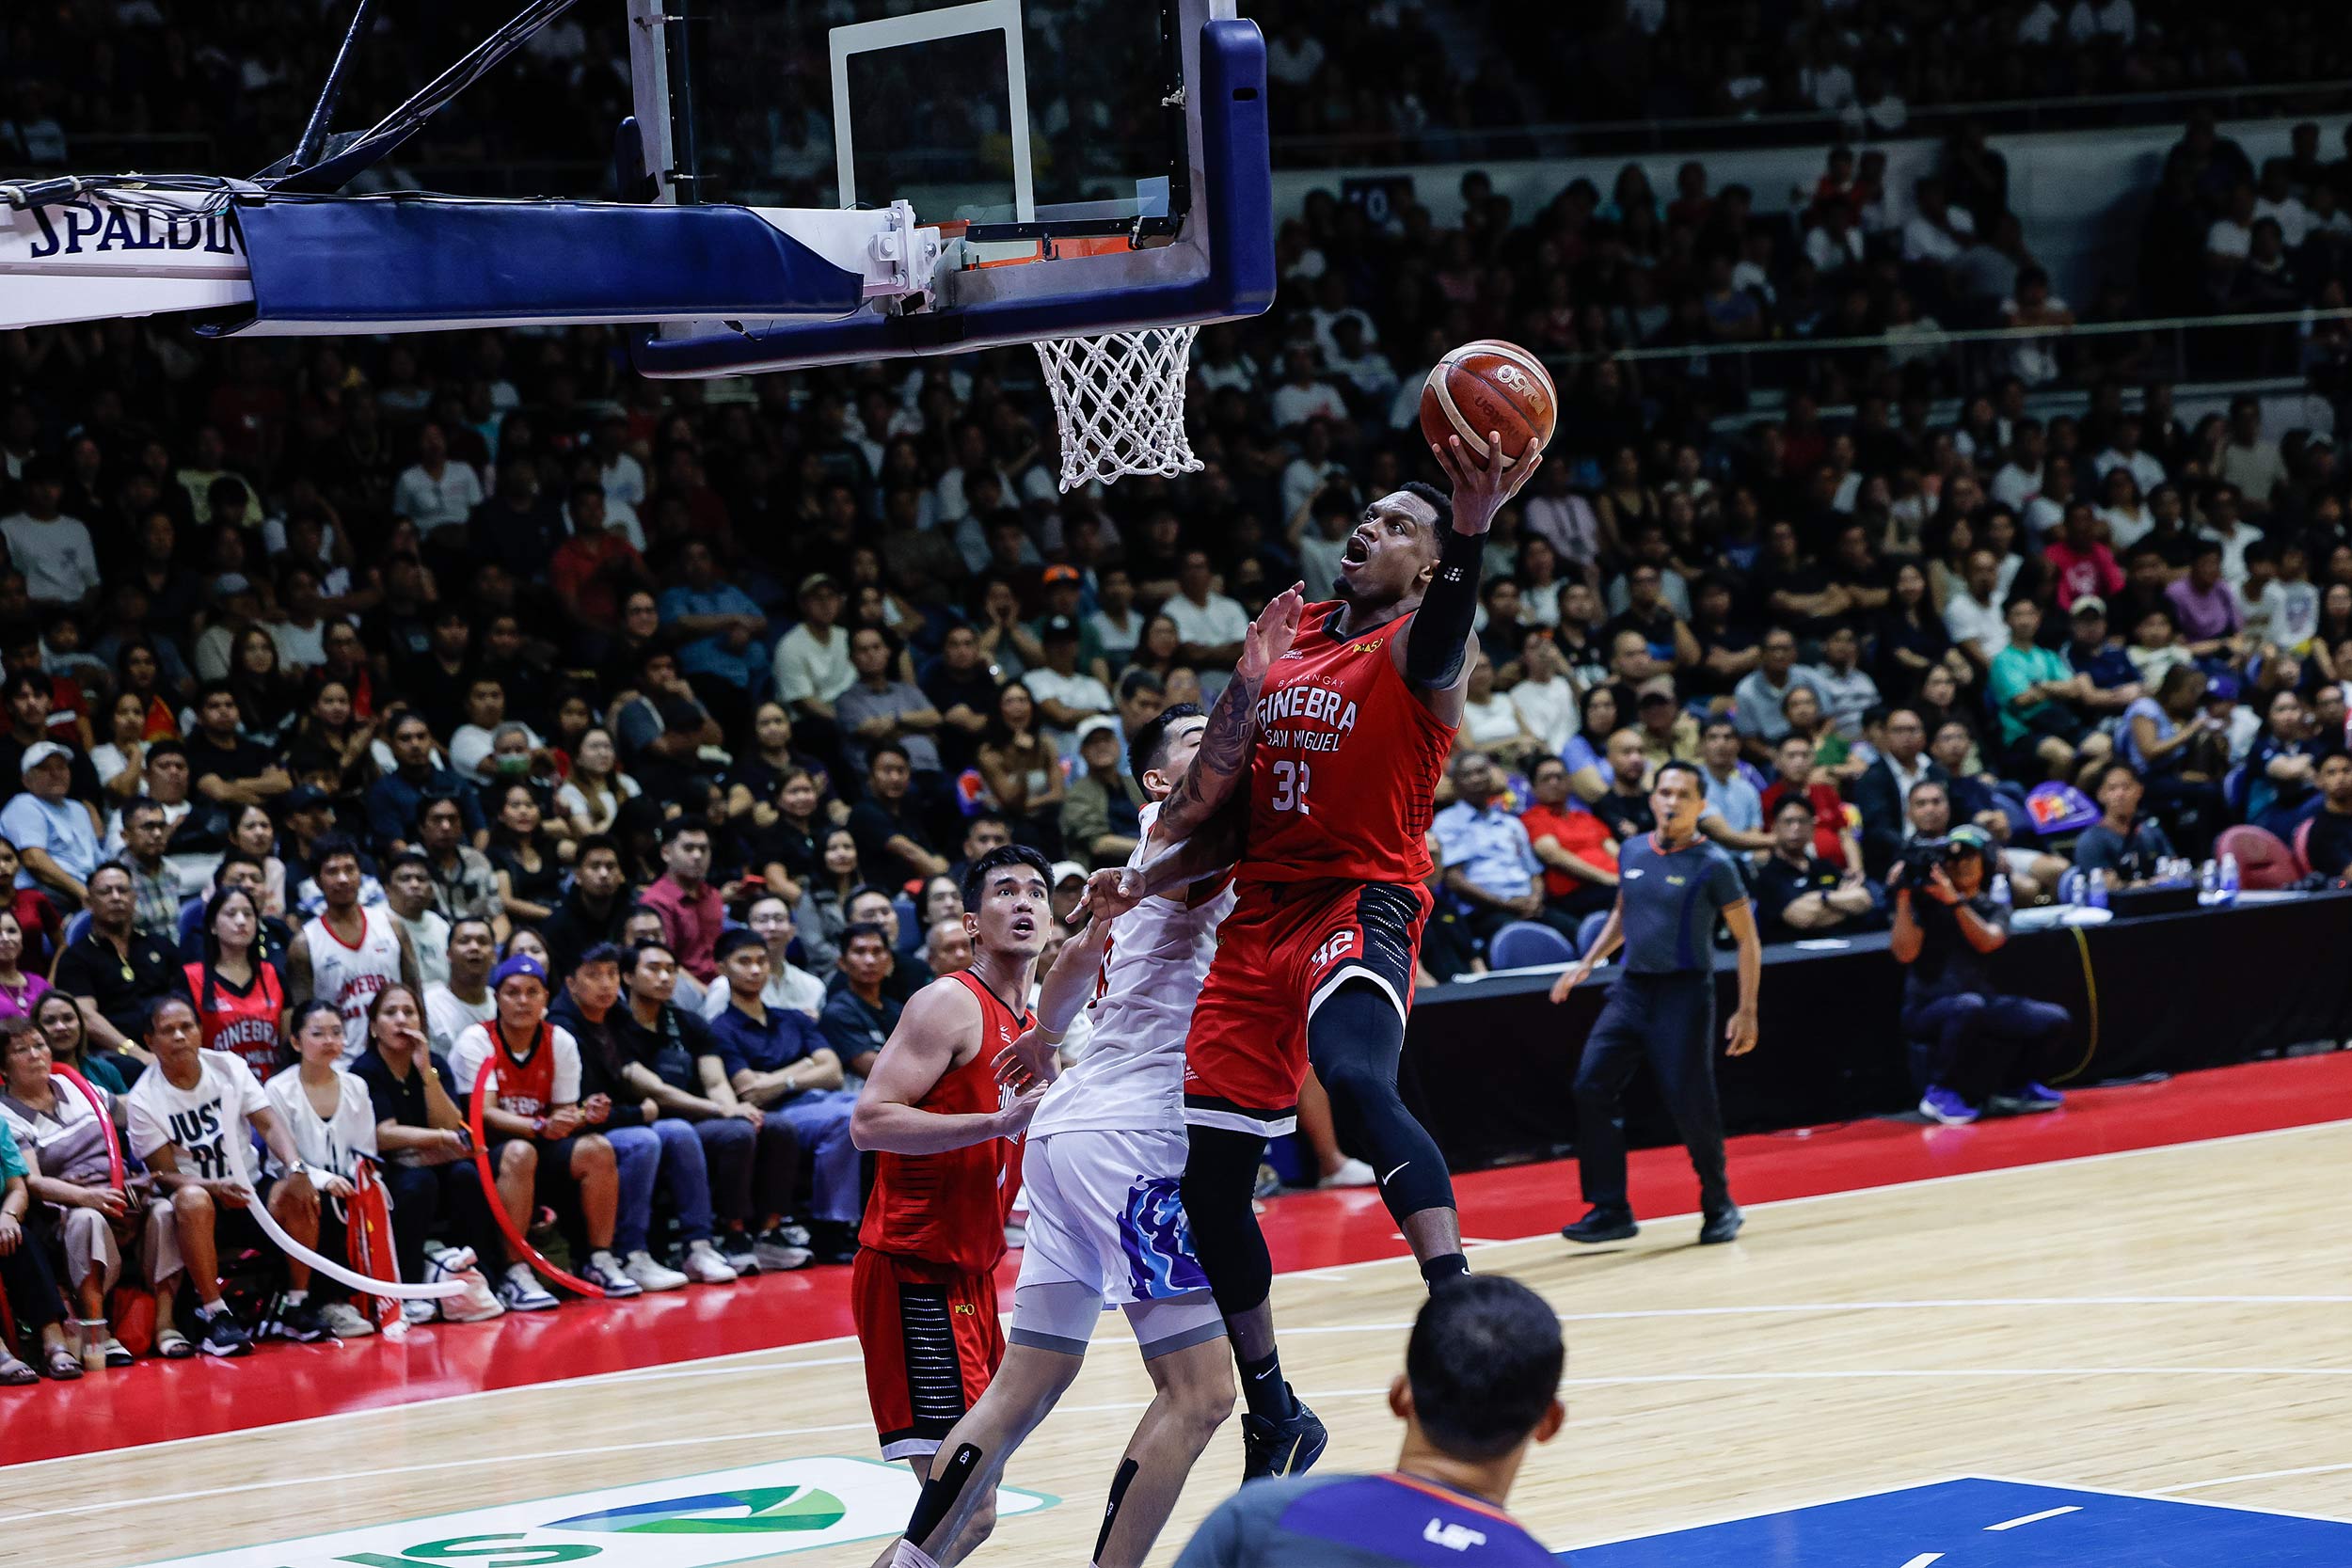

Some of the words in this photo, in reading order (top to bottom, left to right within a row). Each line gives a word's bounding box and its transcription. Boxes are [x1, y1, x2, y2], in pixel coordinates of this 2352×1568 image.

[1278, 673, 1345, 689] BARANGAY
[1256, 686, 1357, 737] GINEBRA
[1264, 729, 1289, 748] SAN
[1293, 729, 1341, 752] MIGUEL
[1272, 760, 1311, 816] 32
